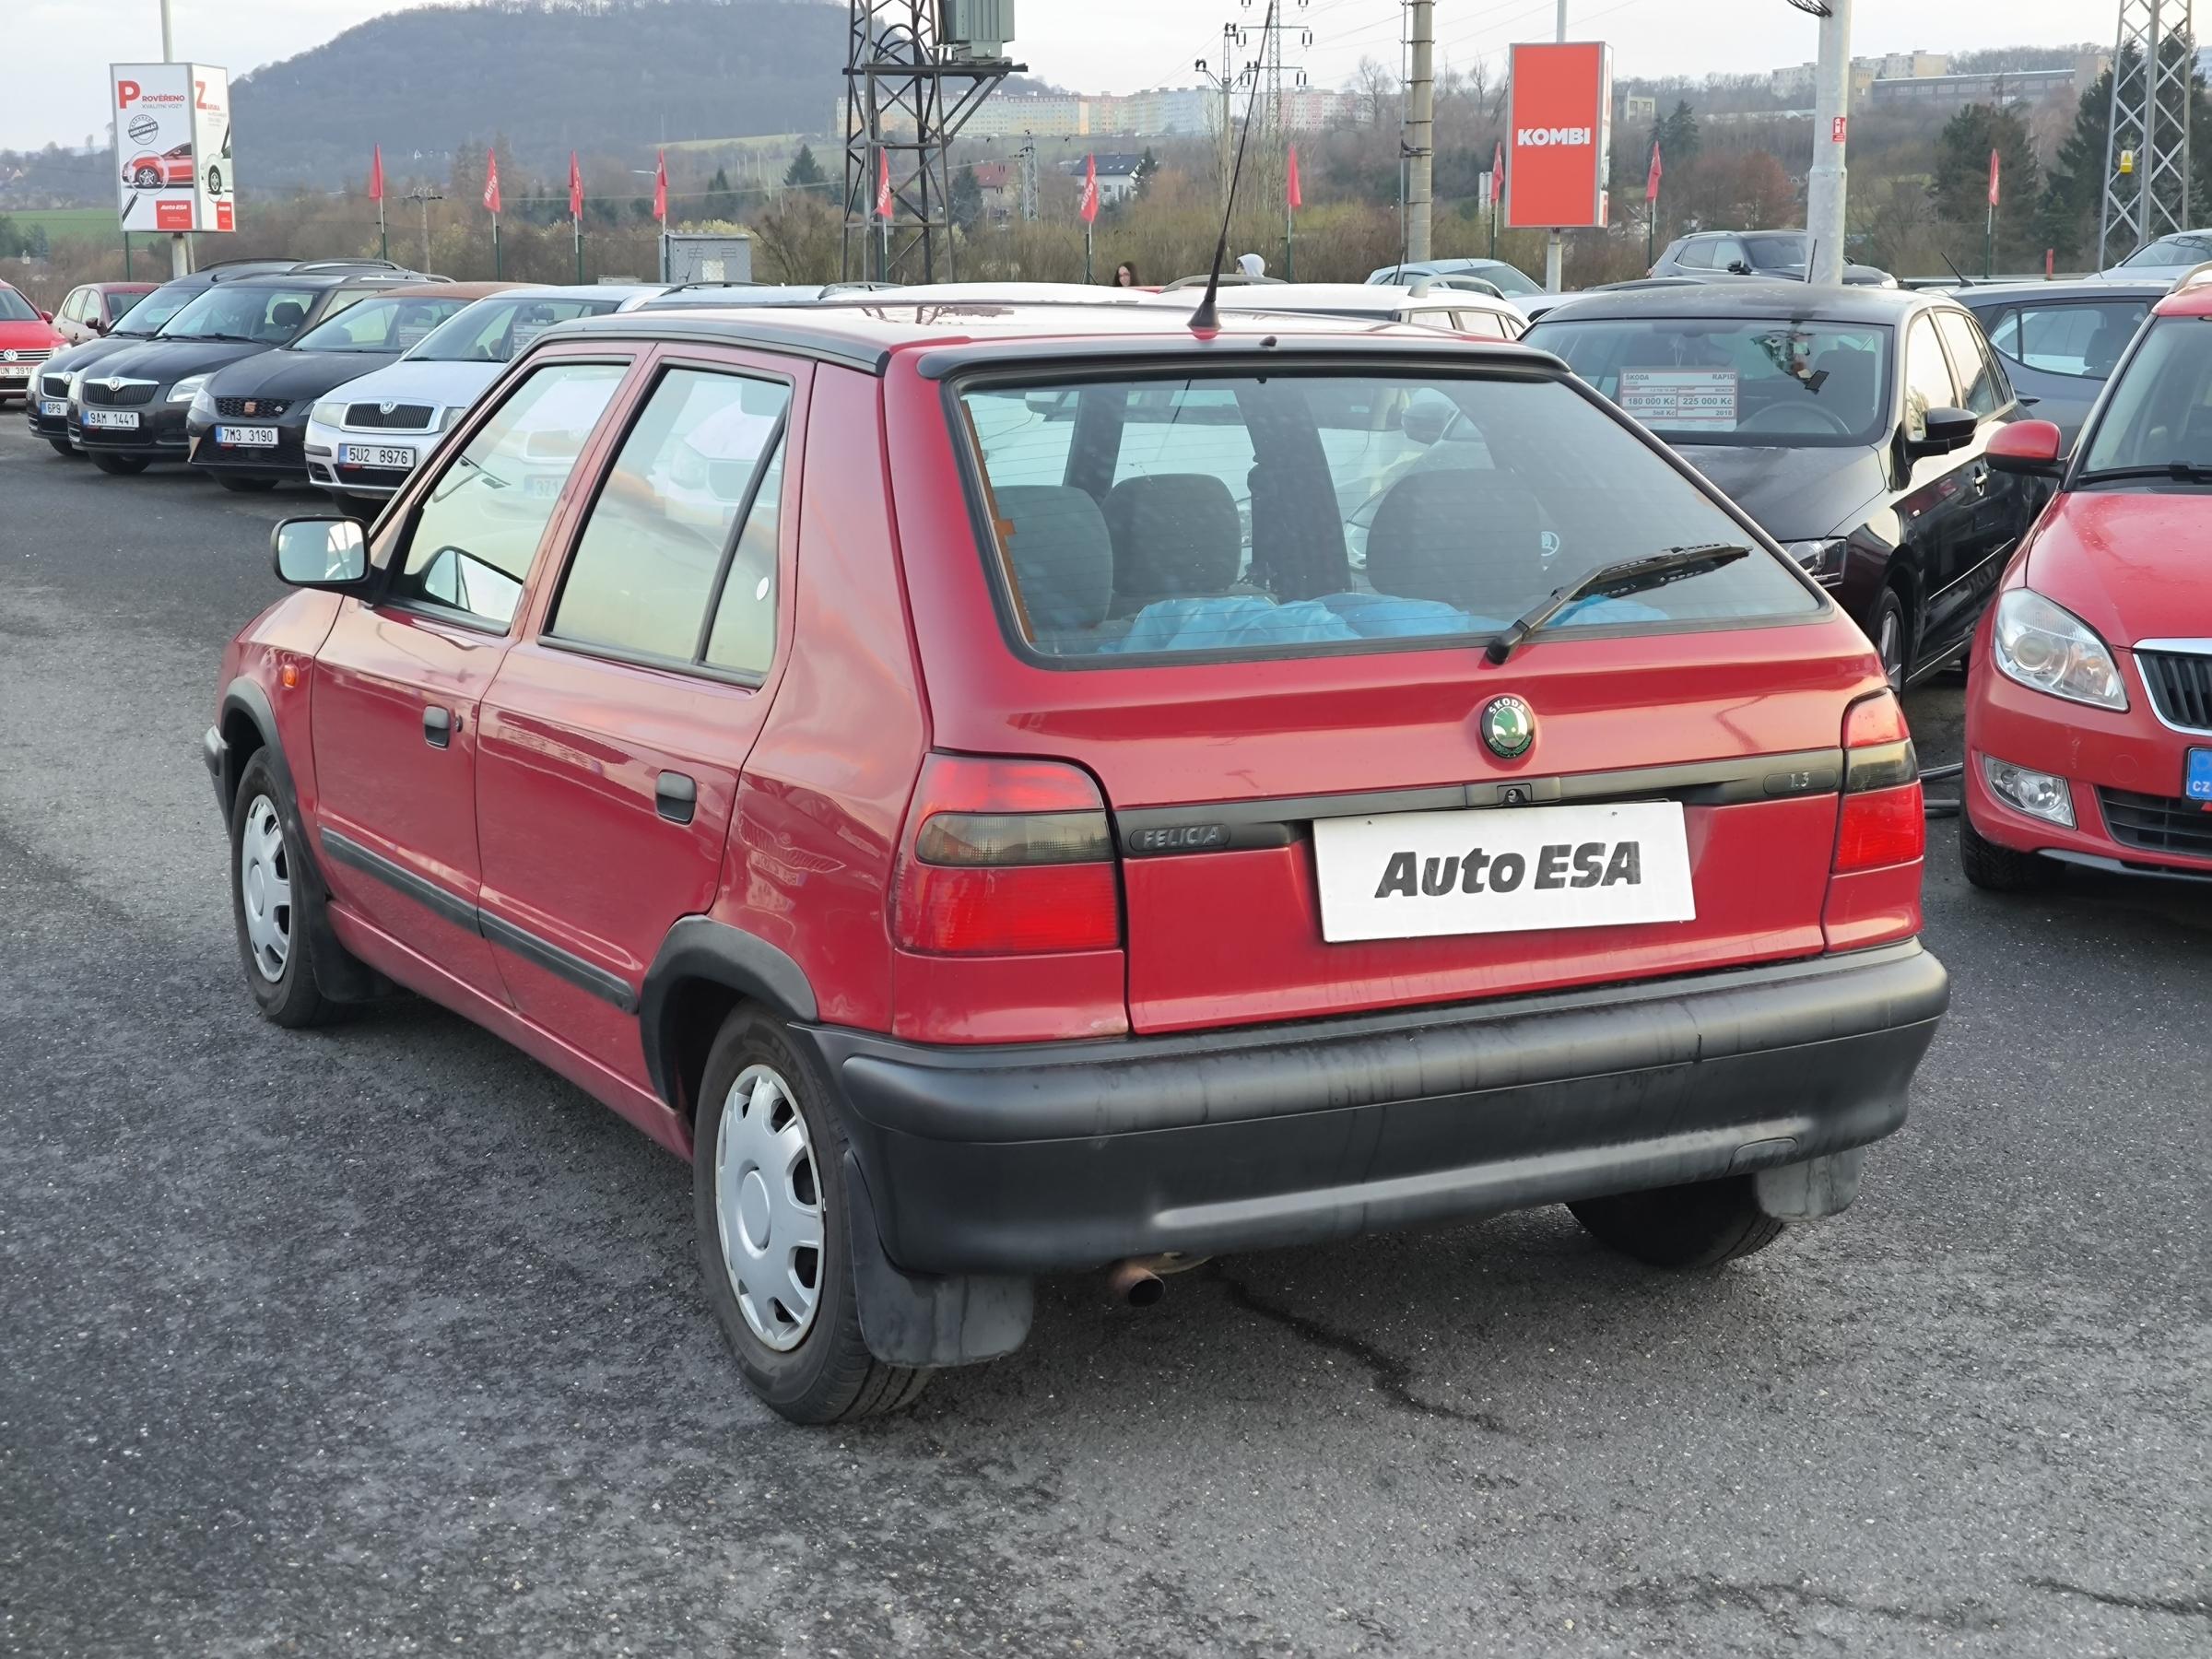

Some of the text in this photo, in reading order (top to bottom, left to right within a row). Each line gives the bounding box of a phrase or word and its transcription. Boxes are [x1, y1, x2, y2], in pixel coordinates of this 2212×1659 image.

[1517, 127, 1591, 146] KOMBI
[90, 413, 135, 425] 9AM 1441
[224, 429, 273, 442] 7M3 3190
[349, 447, 407, 465] 5U2 8976
[2193, 781, 2210, 793] CZ
[1144, 826, 1219, 848] FELICIA
[1374, 841, 1641, 899] Auto ESA
